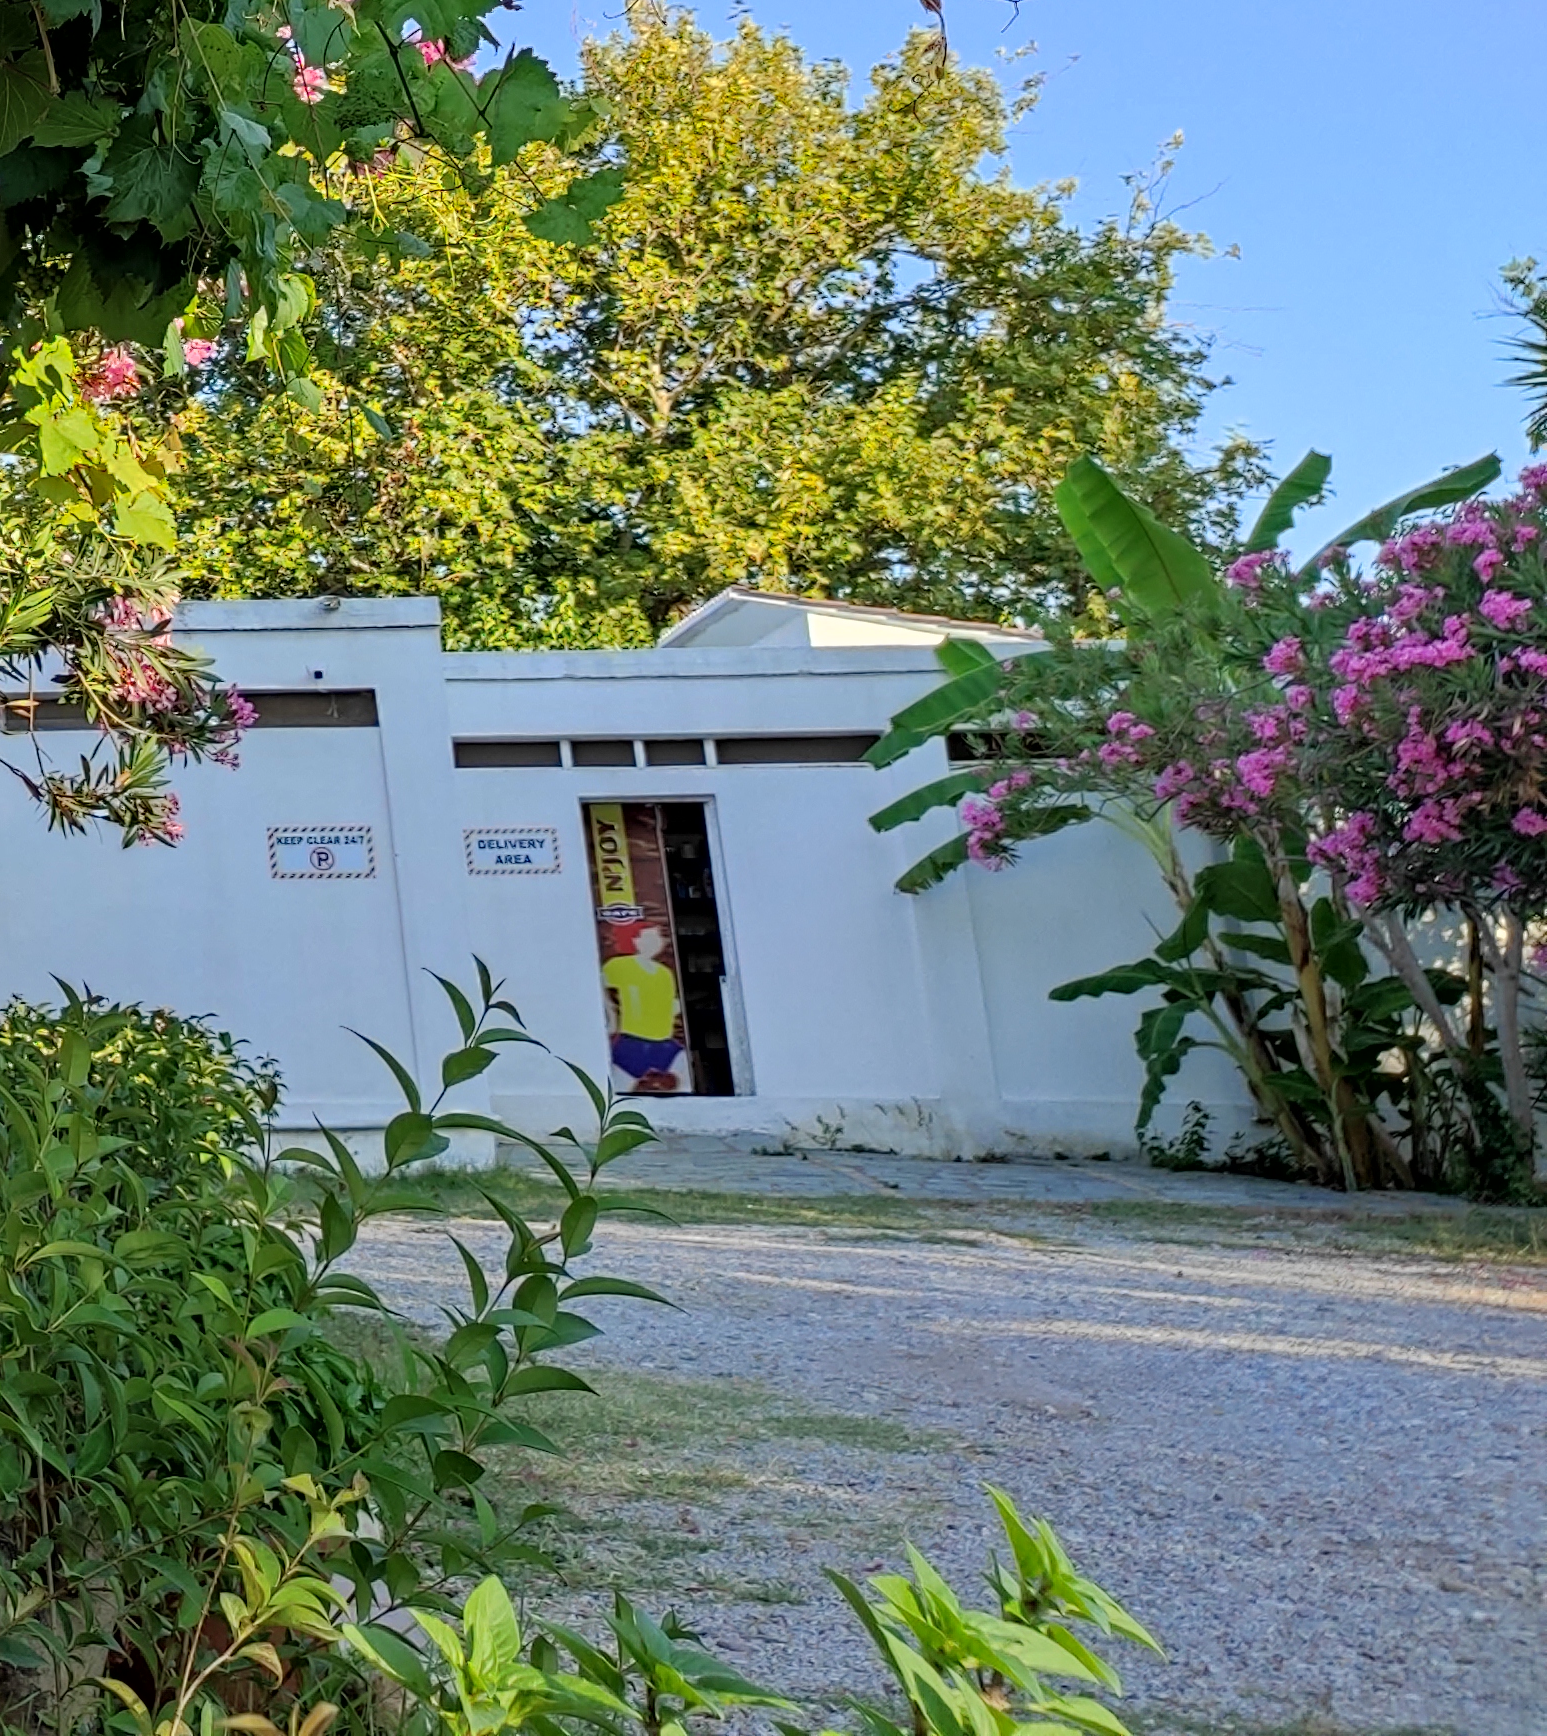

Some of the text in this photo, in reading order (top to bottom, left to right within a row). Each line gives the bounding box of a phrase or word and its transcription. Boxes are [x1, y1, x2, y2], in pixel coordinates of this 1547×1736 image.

[276, 836, 303, 845] KEEP
[307, 835, 341, 845] CLEAR
[477, 838, 545, 850] DELIVERY
[495, 854, 533, 865] AREA
[596, 819, 625, 892] N'JOY
